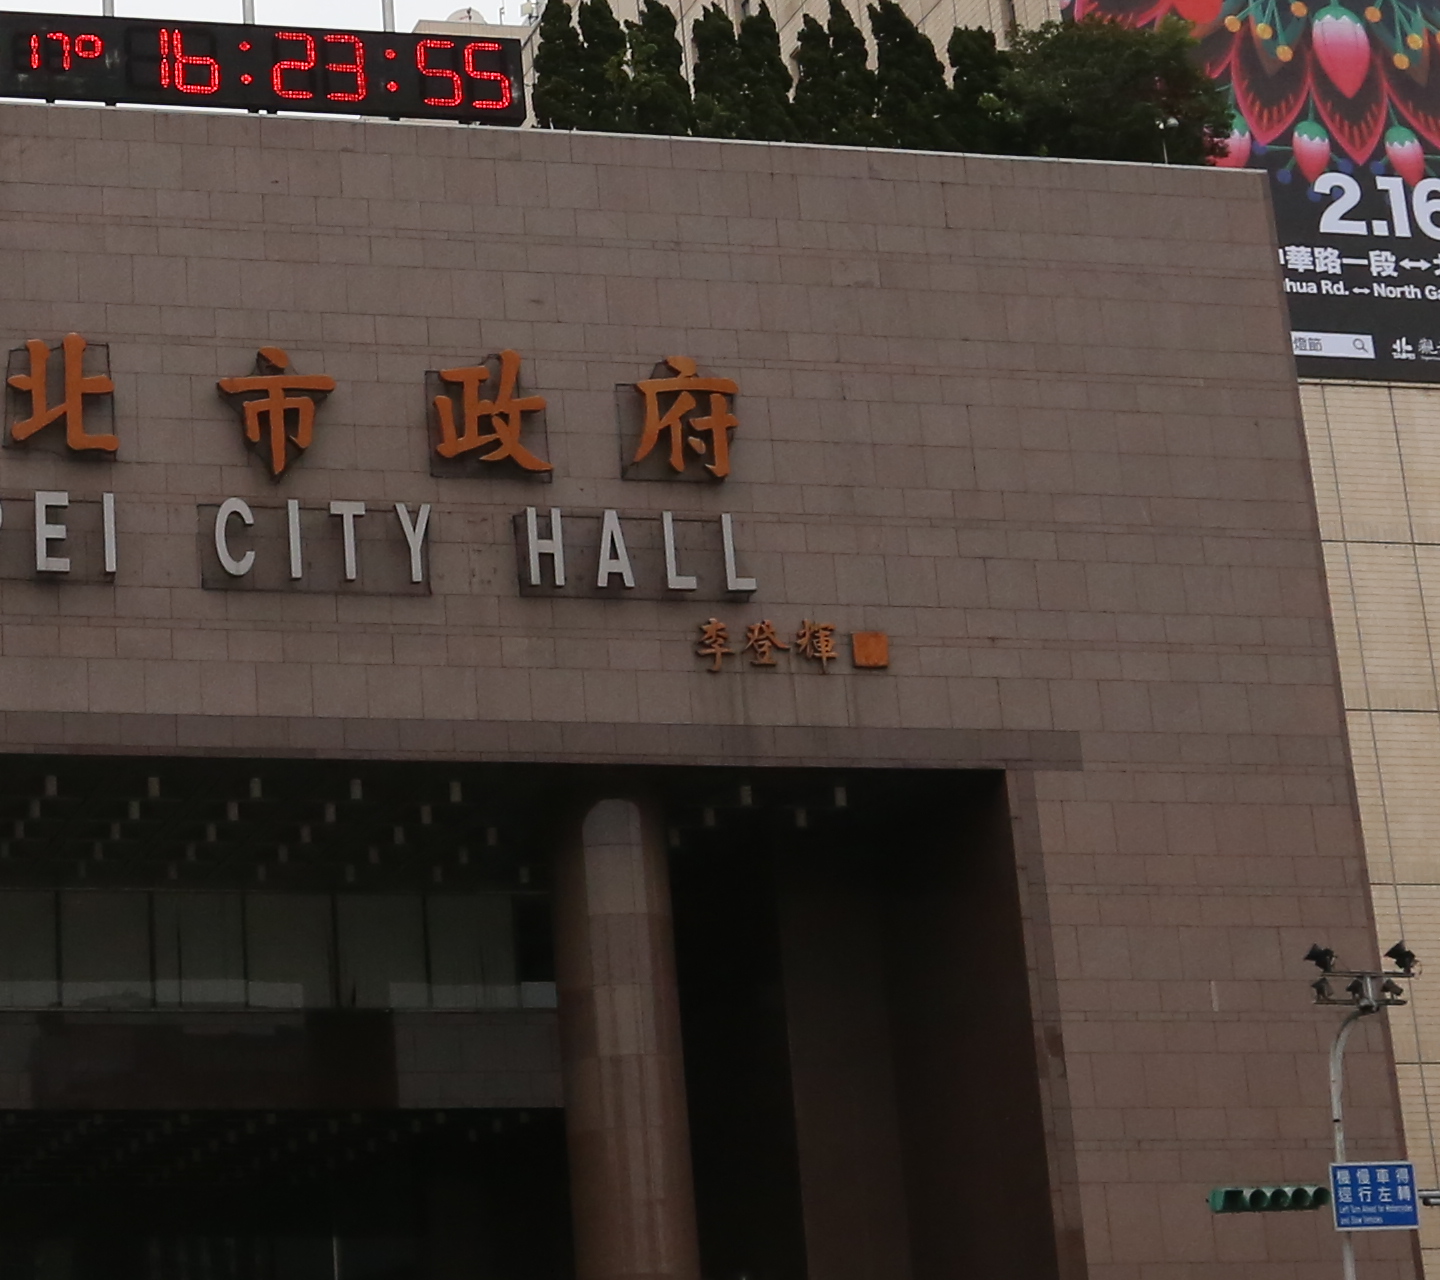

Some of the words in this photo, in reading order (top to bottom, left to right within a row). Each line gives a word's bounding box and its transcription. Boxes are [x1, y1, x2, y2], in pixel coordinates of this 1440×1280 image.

[158, 28, 512, 110] 16:23:55
[1283, 278, 1317, 294] hua
[1320, 279, 1349, 295] Rd.
[1372, 283, 1421, 299] North
[214, 495, 434, 583] CITY
[524, 505, 758, 592] HALL
